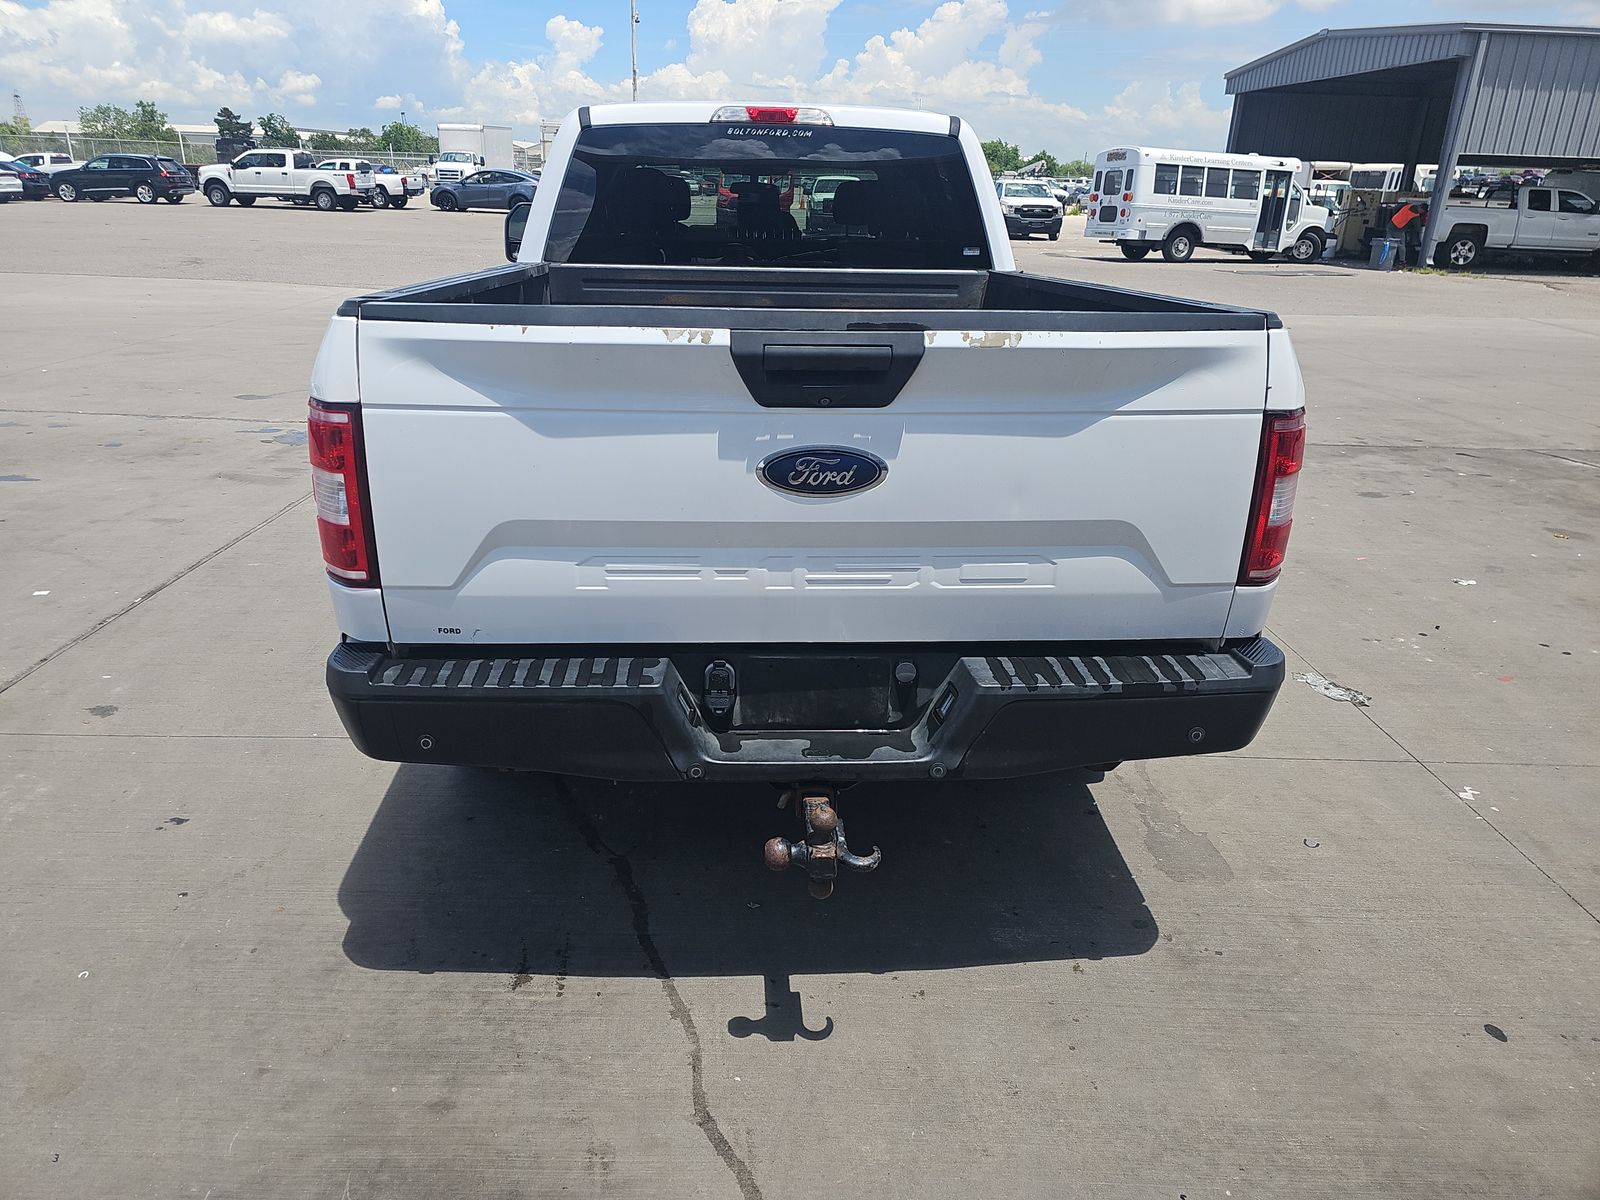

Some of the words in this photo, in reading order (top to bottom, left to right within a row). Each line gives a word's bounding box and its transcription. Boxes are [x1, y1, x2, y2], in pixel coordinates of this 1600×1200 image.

[726, 127, 813, 138] BOLTONFORD.COM
[1169, 153, 1204, 164] KinderCare
[1204, 156, 1231, 167] Learning
[1231, 158, 1254, 167] Centers
[1167, 196, 1214, 206] KinderCare.com
[787, 456, 858, 486] Ford
[437, 627, 462, 635] FORD
